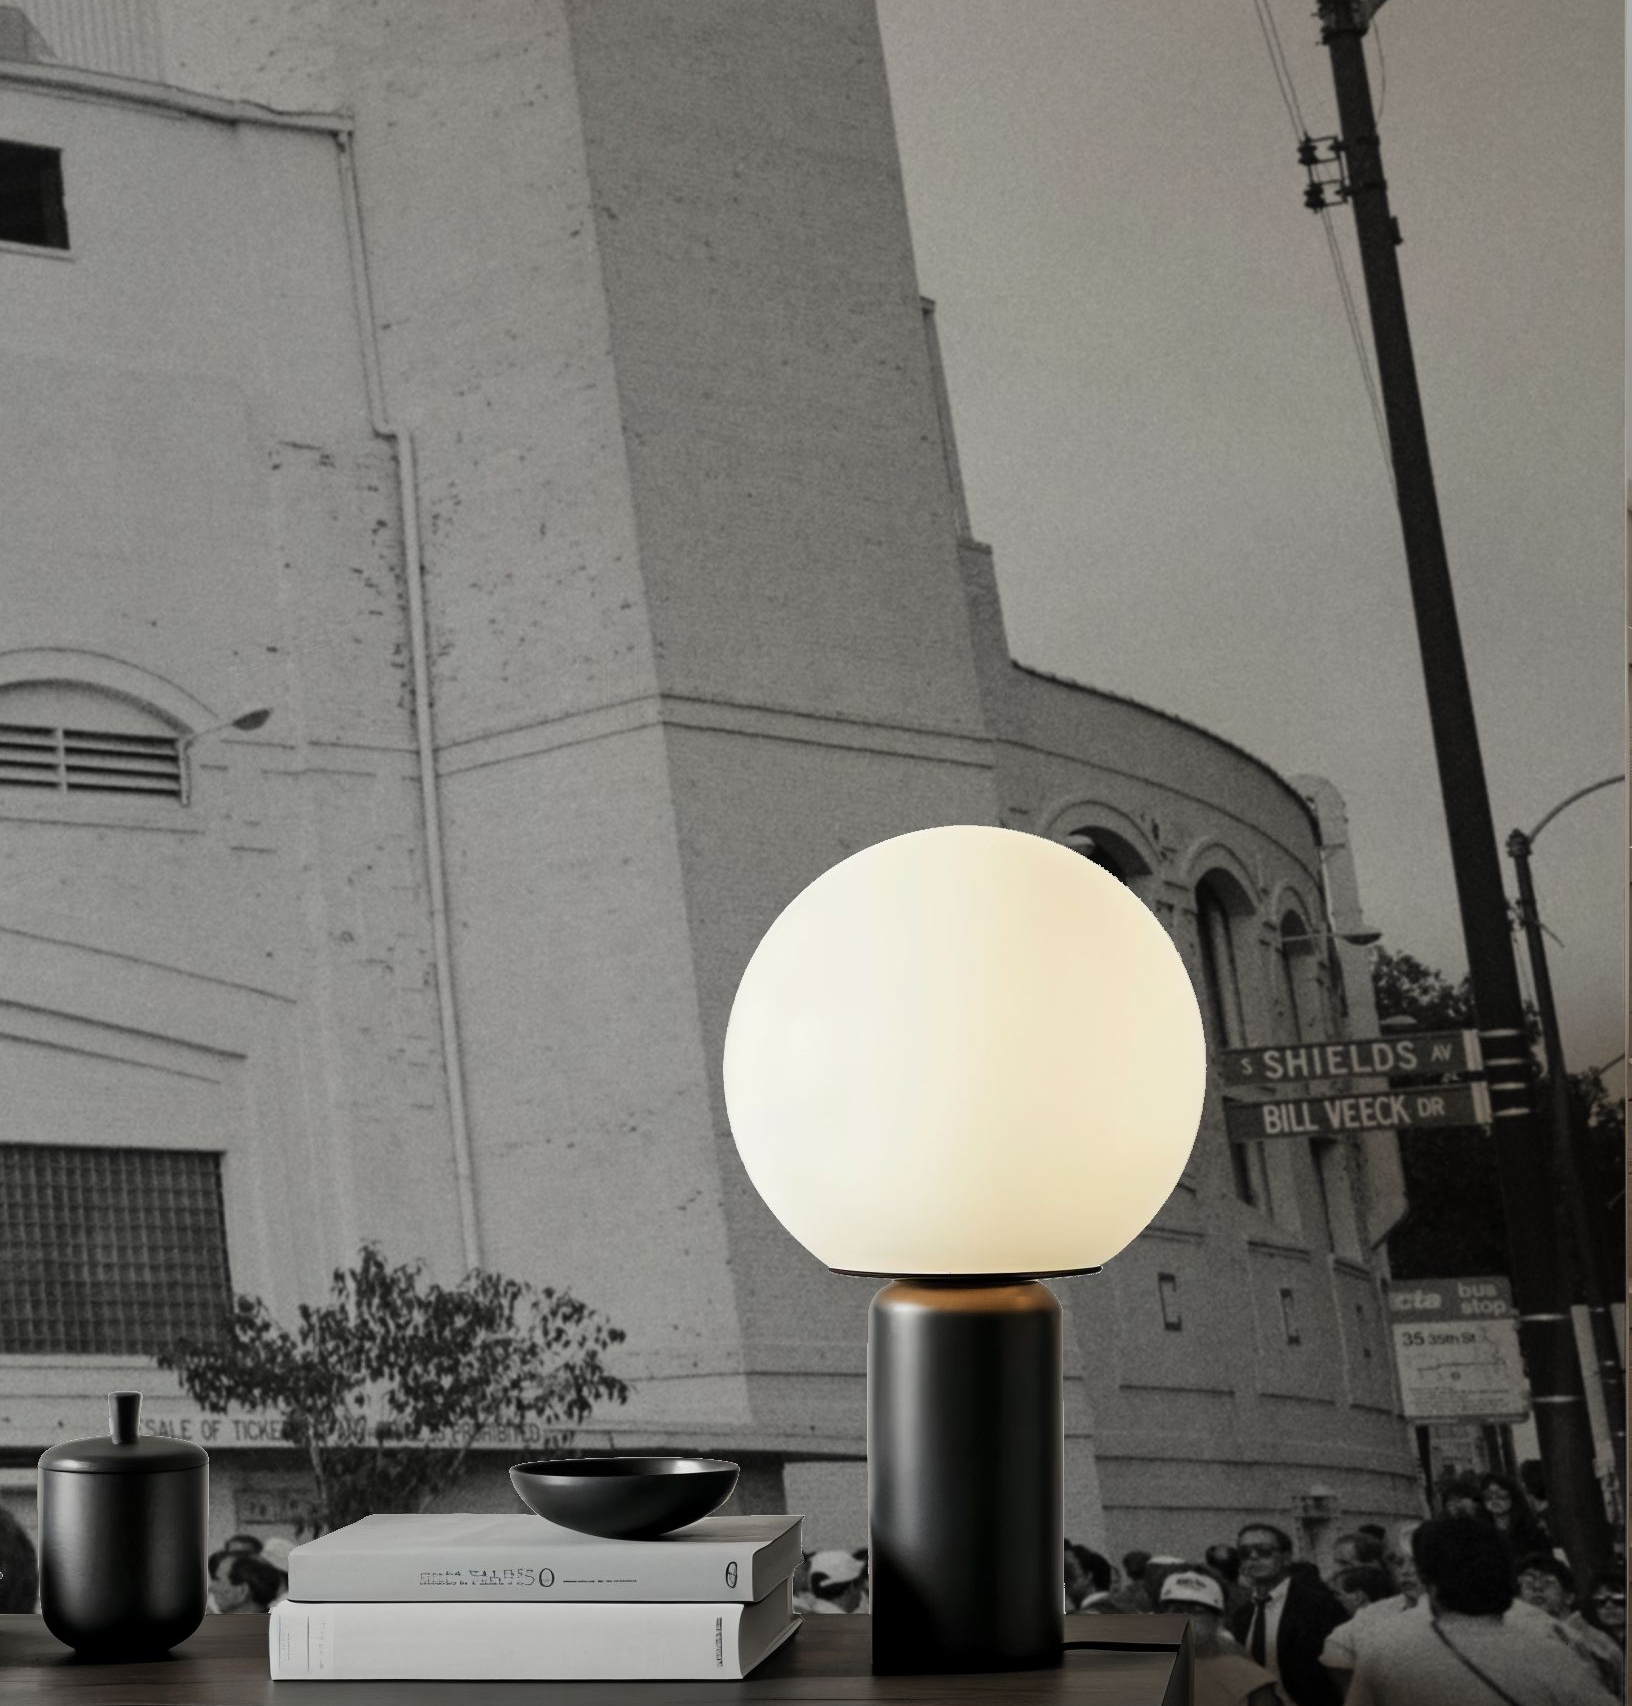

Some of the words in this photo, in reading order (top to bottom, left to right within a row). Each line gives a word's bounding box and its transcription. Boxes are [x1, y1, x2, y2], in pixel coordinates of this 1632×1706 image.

[1240, 1057, 1253, 1076] S
[1263, 1040, 1418, 1080] SHIELDS
[1430, 1043, 1453, 1063] AV
[1262, 1101, 1320, 1134] BILL
[1323, 1094, 1412, 1130] VEECK
[1418, 1096, 1446, 1118] DR
[1460, 1298, 1508, 1317] stop
[1401, 1330, 1426, 1347] 35
[232, 1418, 298, 1442] TICKE
